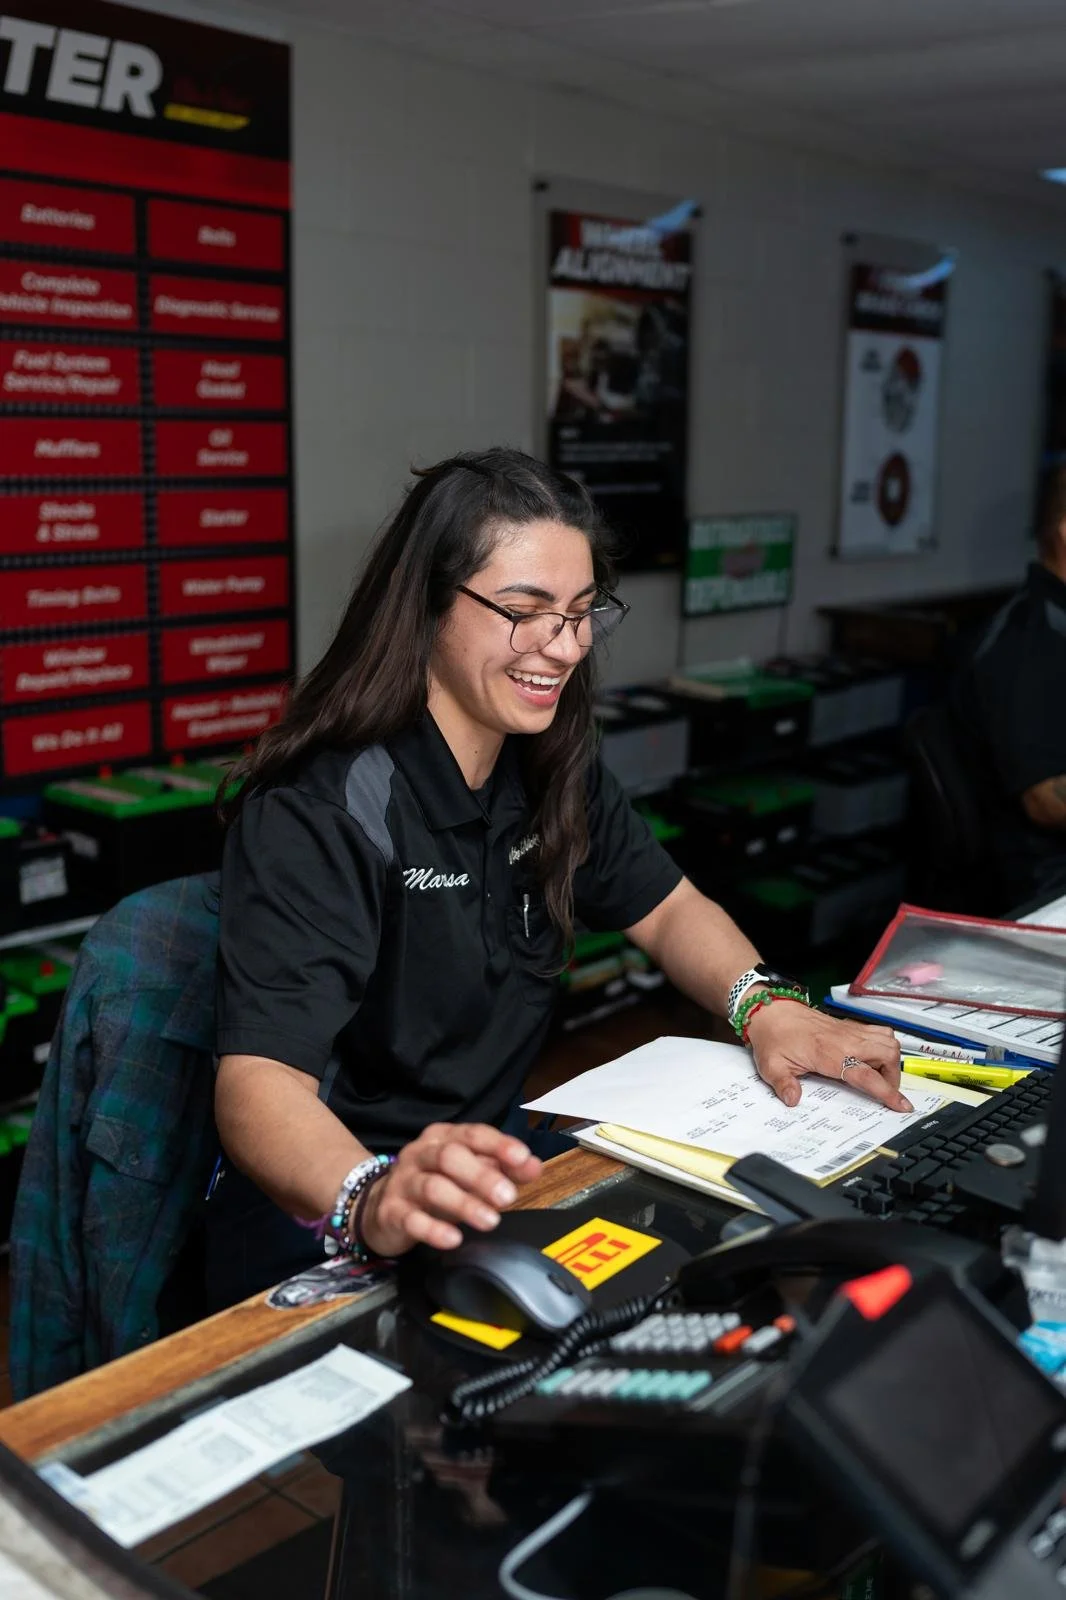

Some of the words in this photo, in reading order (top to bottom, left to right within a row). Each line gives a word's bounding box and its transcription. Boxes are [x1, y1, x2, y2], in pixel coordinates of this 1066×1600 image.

[0, 15, 163, 119] TER
[21, 271, 101, 296] Complete
[50, 295, 133, 320] Inspection
[154, 295, 229, 319] Diagnostic
[230, 301, 281, 323] Service
[13, 350, 50, 371] Fuel
[52, 351, 111, 374] System
[34, 438, 101, 458] Mufflers
[197, 448, 249, 467] Service
[403, 867, 470, 891] Marsa
